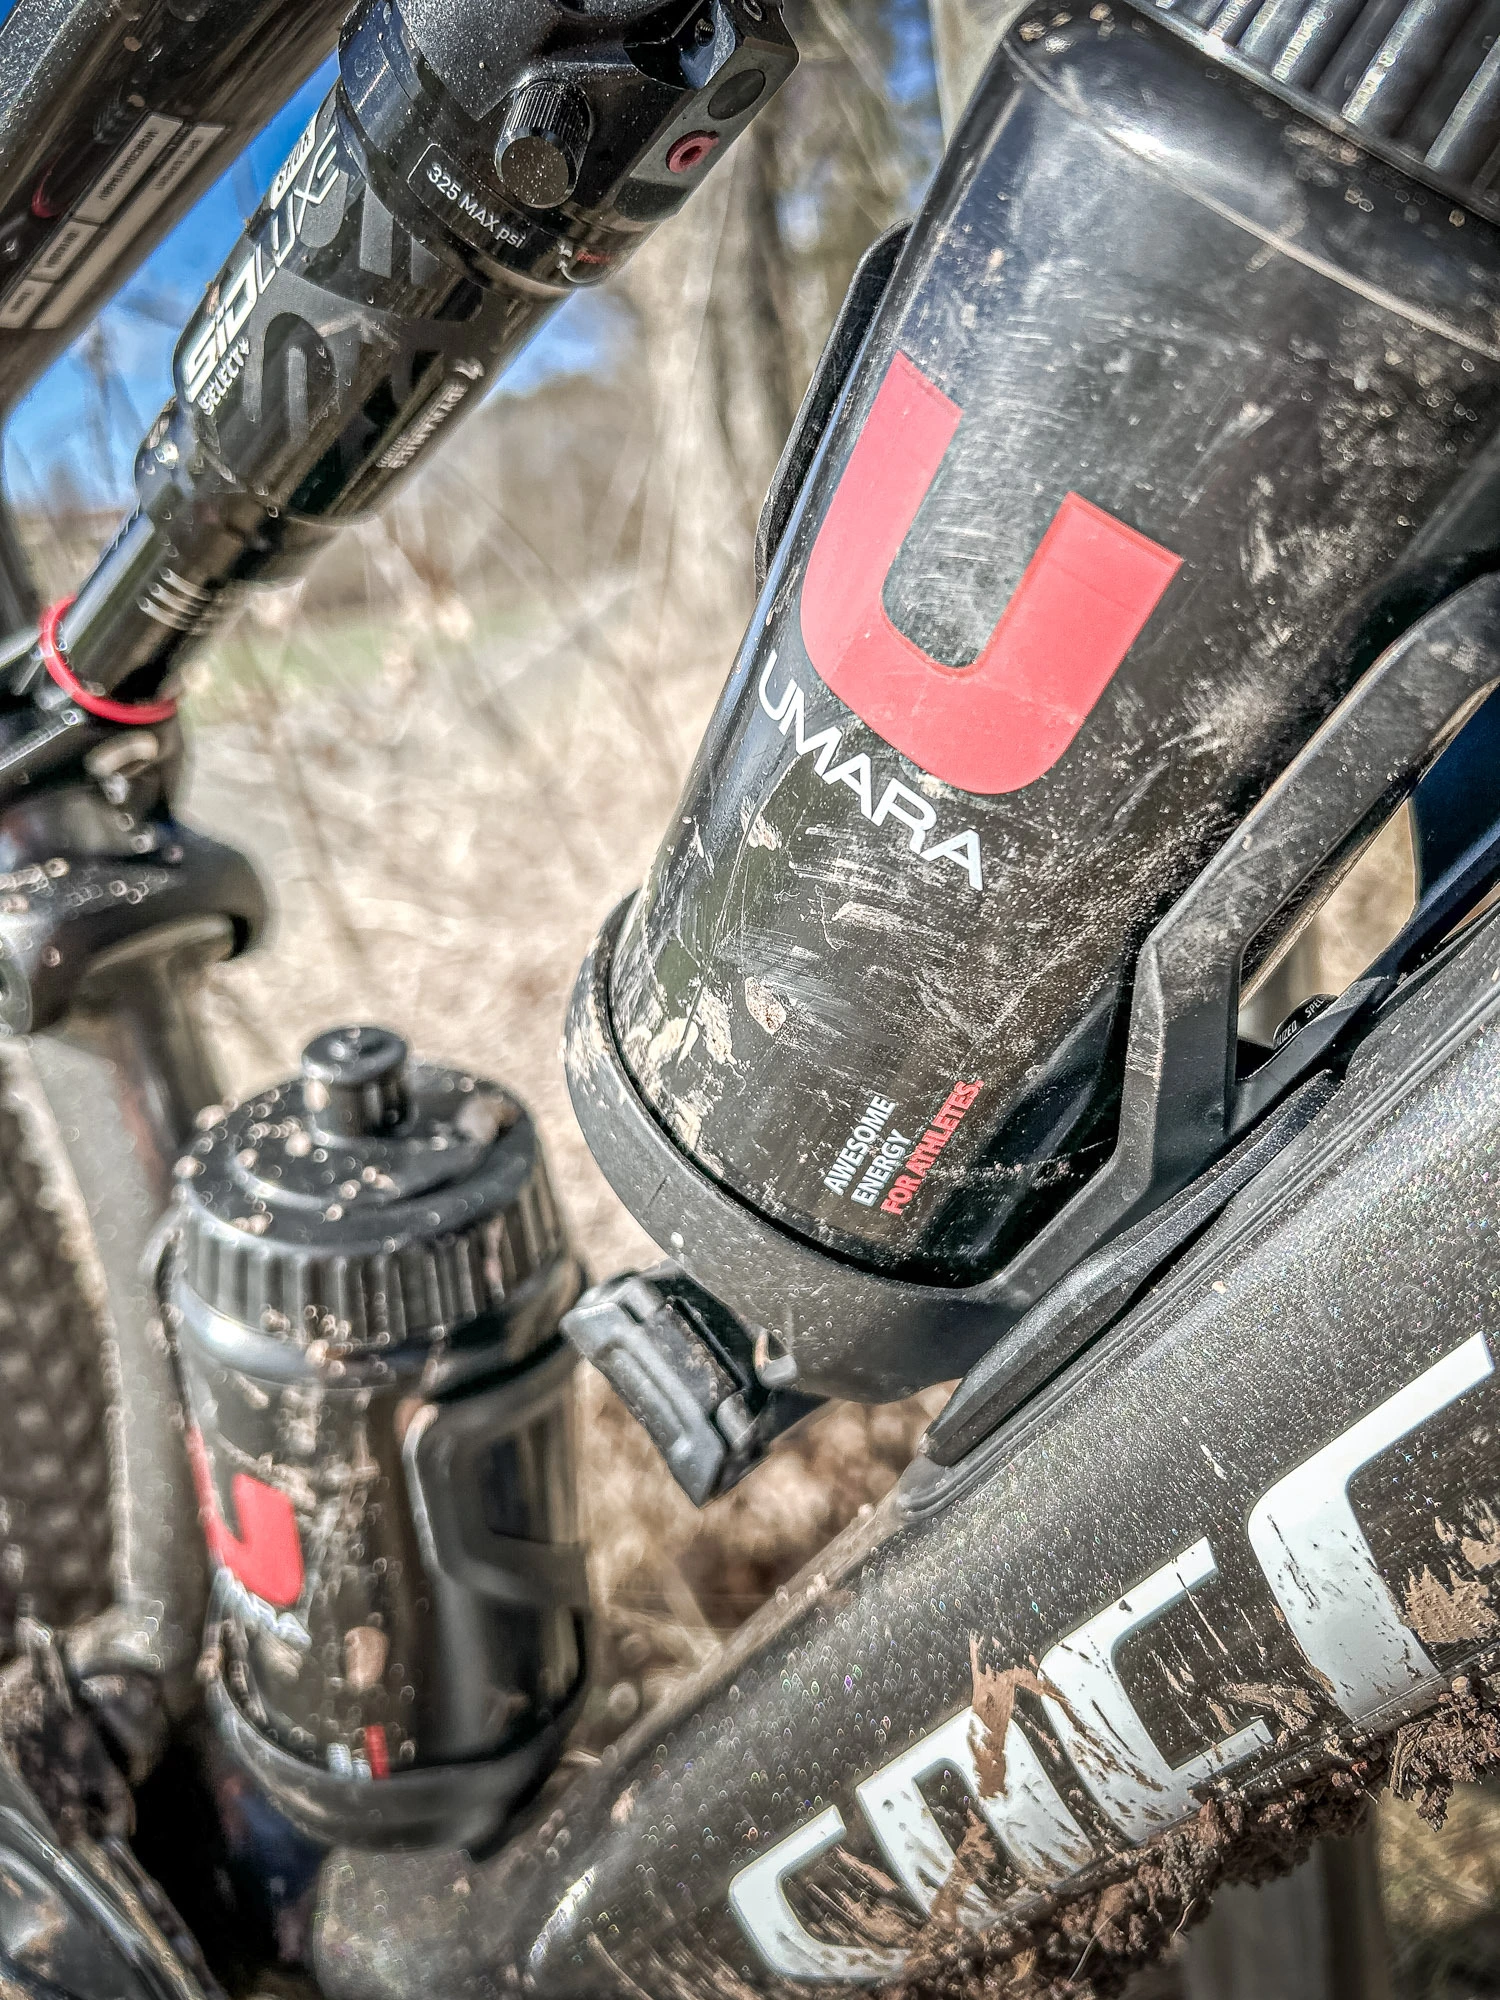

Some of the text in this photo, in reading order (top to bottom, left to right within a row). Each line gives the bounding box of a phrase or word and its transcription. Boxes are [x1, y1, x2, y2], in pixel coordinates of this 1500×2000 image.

[427, 162, 527, 249] 325 MAX psi
[758, 650, 984, 891] UMARA
[823, 1096, 897, 1195] AWESOME
[851, 1129, 912, 1207] ENERGY
[880, 1079, 985, 1216] FOR ATHLETES.
